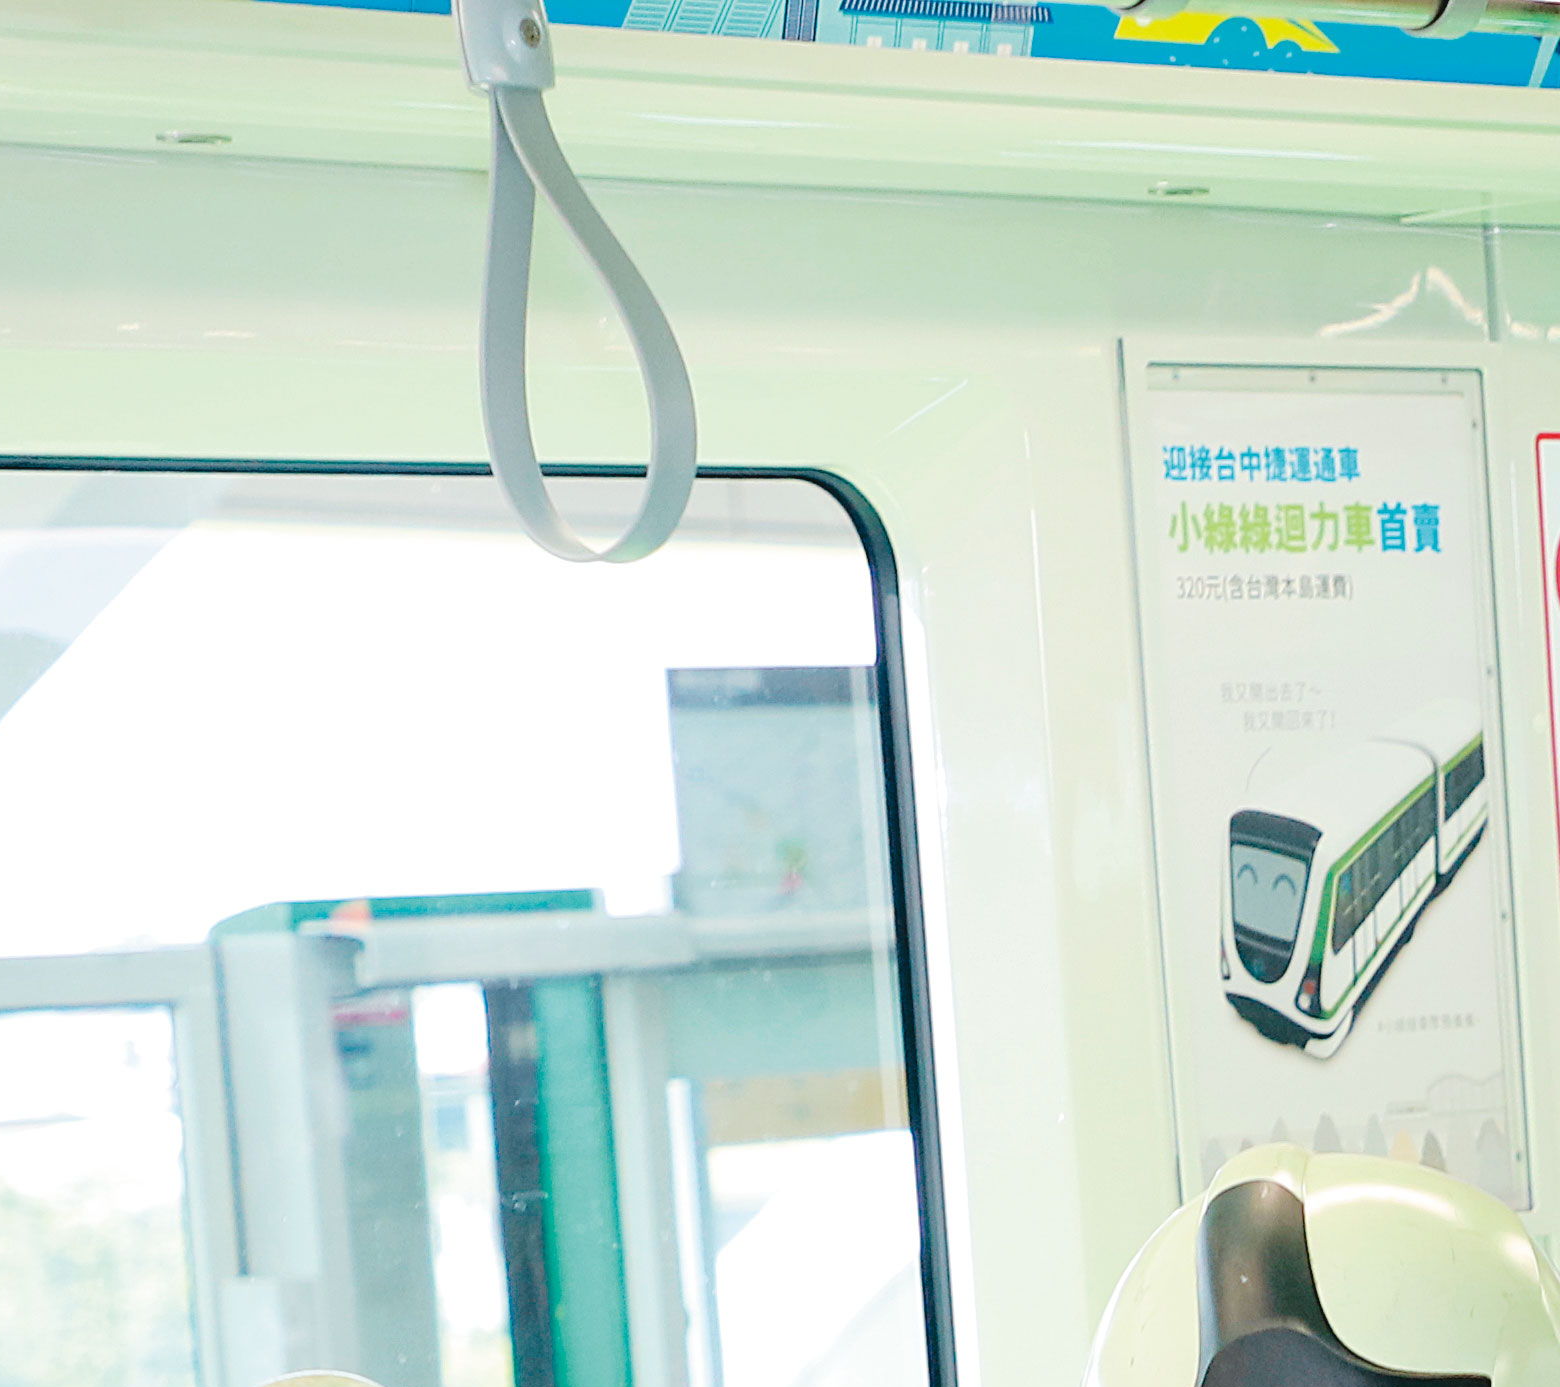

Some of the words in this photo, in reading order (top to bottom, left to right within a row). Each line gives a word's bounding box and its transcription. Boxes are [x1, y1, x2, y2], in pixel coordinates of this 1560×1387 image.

[1162, 445, 1361, 483] 迎接台中捷運通車
[1168, 499, 1442, 553] 小綠綠迴力車首賣
